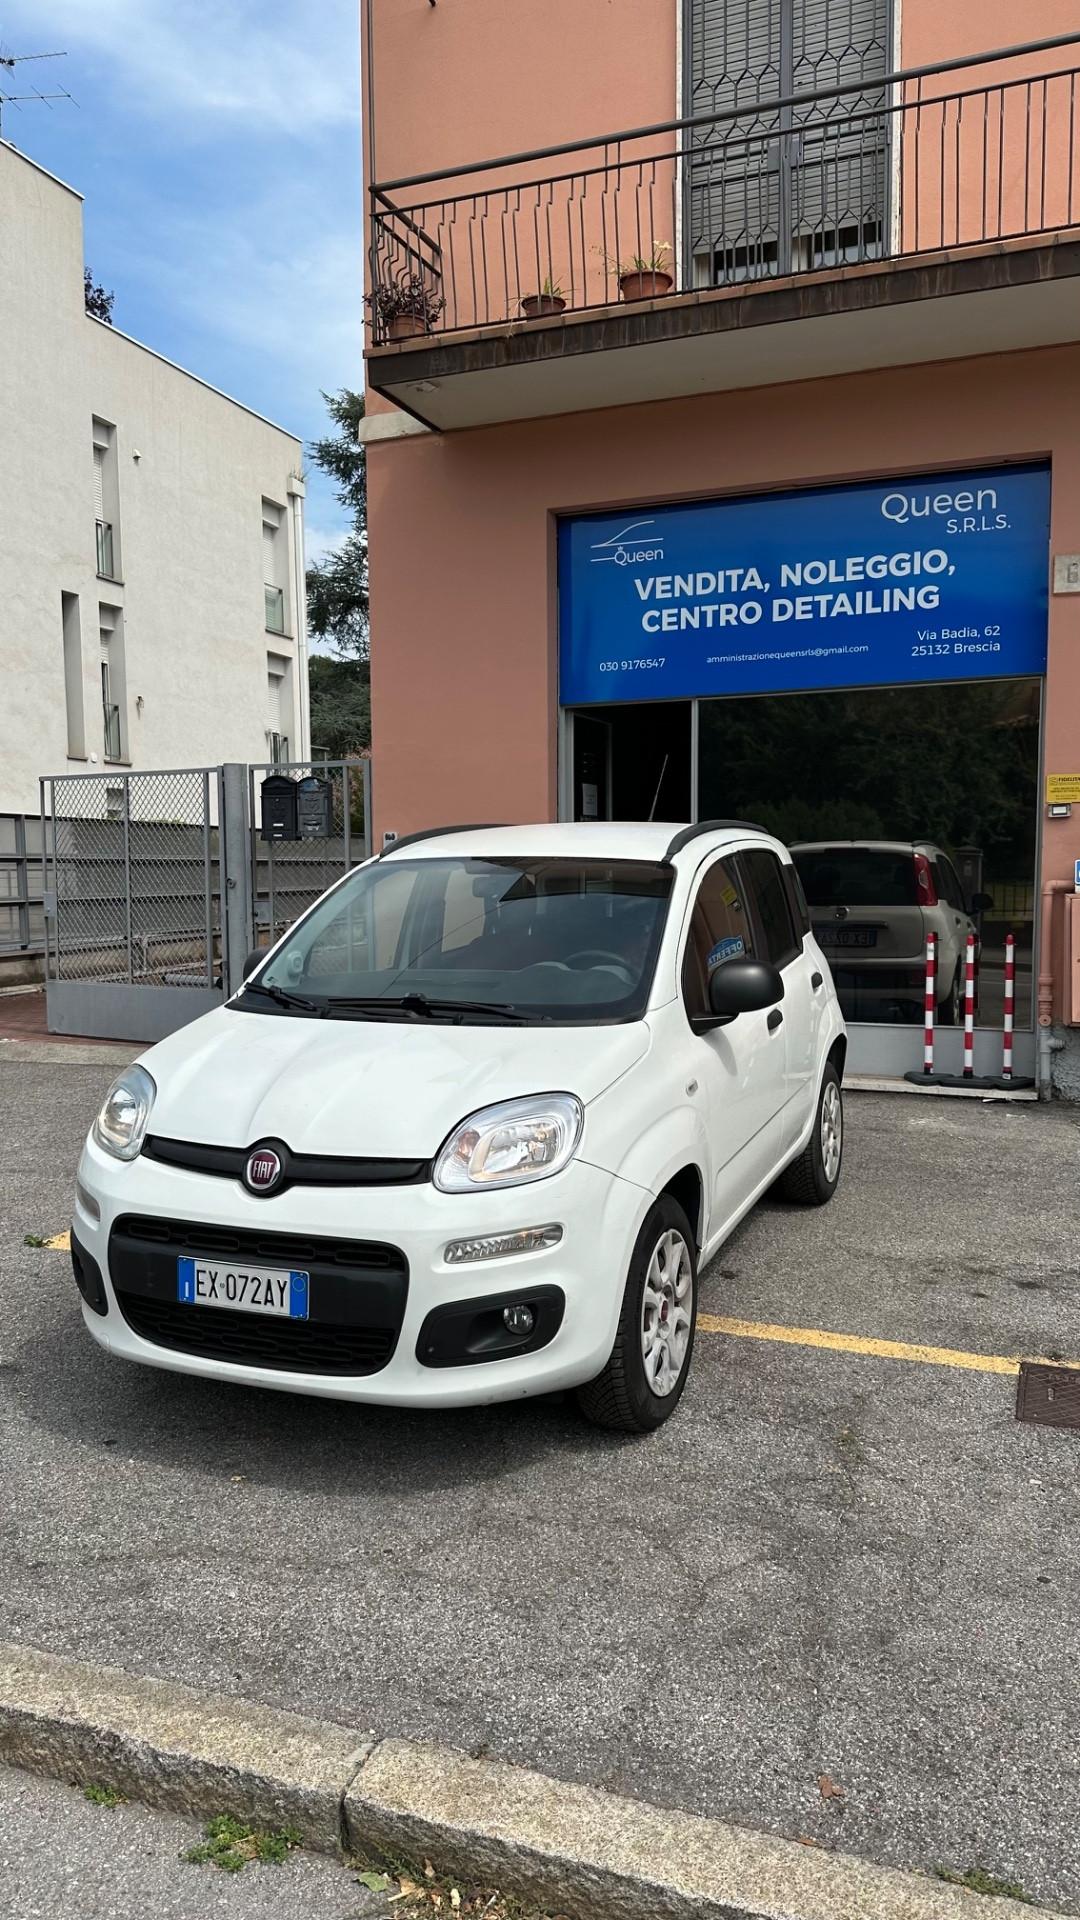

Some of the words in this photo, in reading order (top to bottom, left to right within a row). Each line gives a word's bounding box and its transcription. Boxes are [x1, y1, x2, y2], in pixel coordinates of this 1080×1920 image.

[881, 488, 997, 524] Queen
[946, 513, 1012, 534] S.R.L.S.
[614, 548, 664, 566] Queen
[634, 567, 771, 601] VENDITA,
[780, 548, 956, 588] NOLEGGIO,
[641, 600, 763, 633] CENTRO
[772, 585, 940, 622] DETAILING
[917, 629, 938, 641] Via
[941, 627, 981, 639] Badia,
[984, 625, 1001, 637] 62
[706, 643, 869, 664] amministrazionequeensrls@gmail.com
[911, 644, 950, 657] 25132
[954, 640, 1001, 654] Brescia
[600, 661, 619, 672] 030
[621, 657, 666, 671] 9176547
[253, 1160, 274, 1179] FIAT
